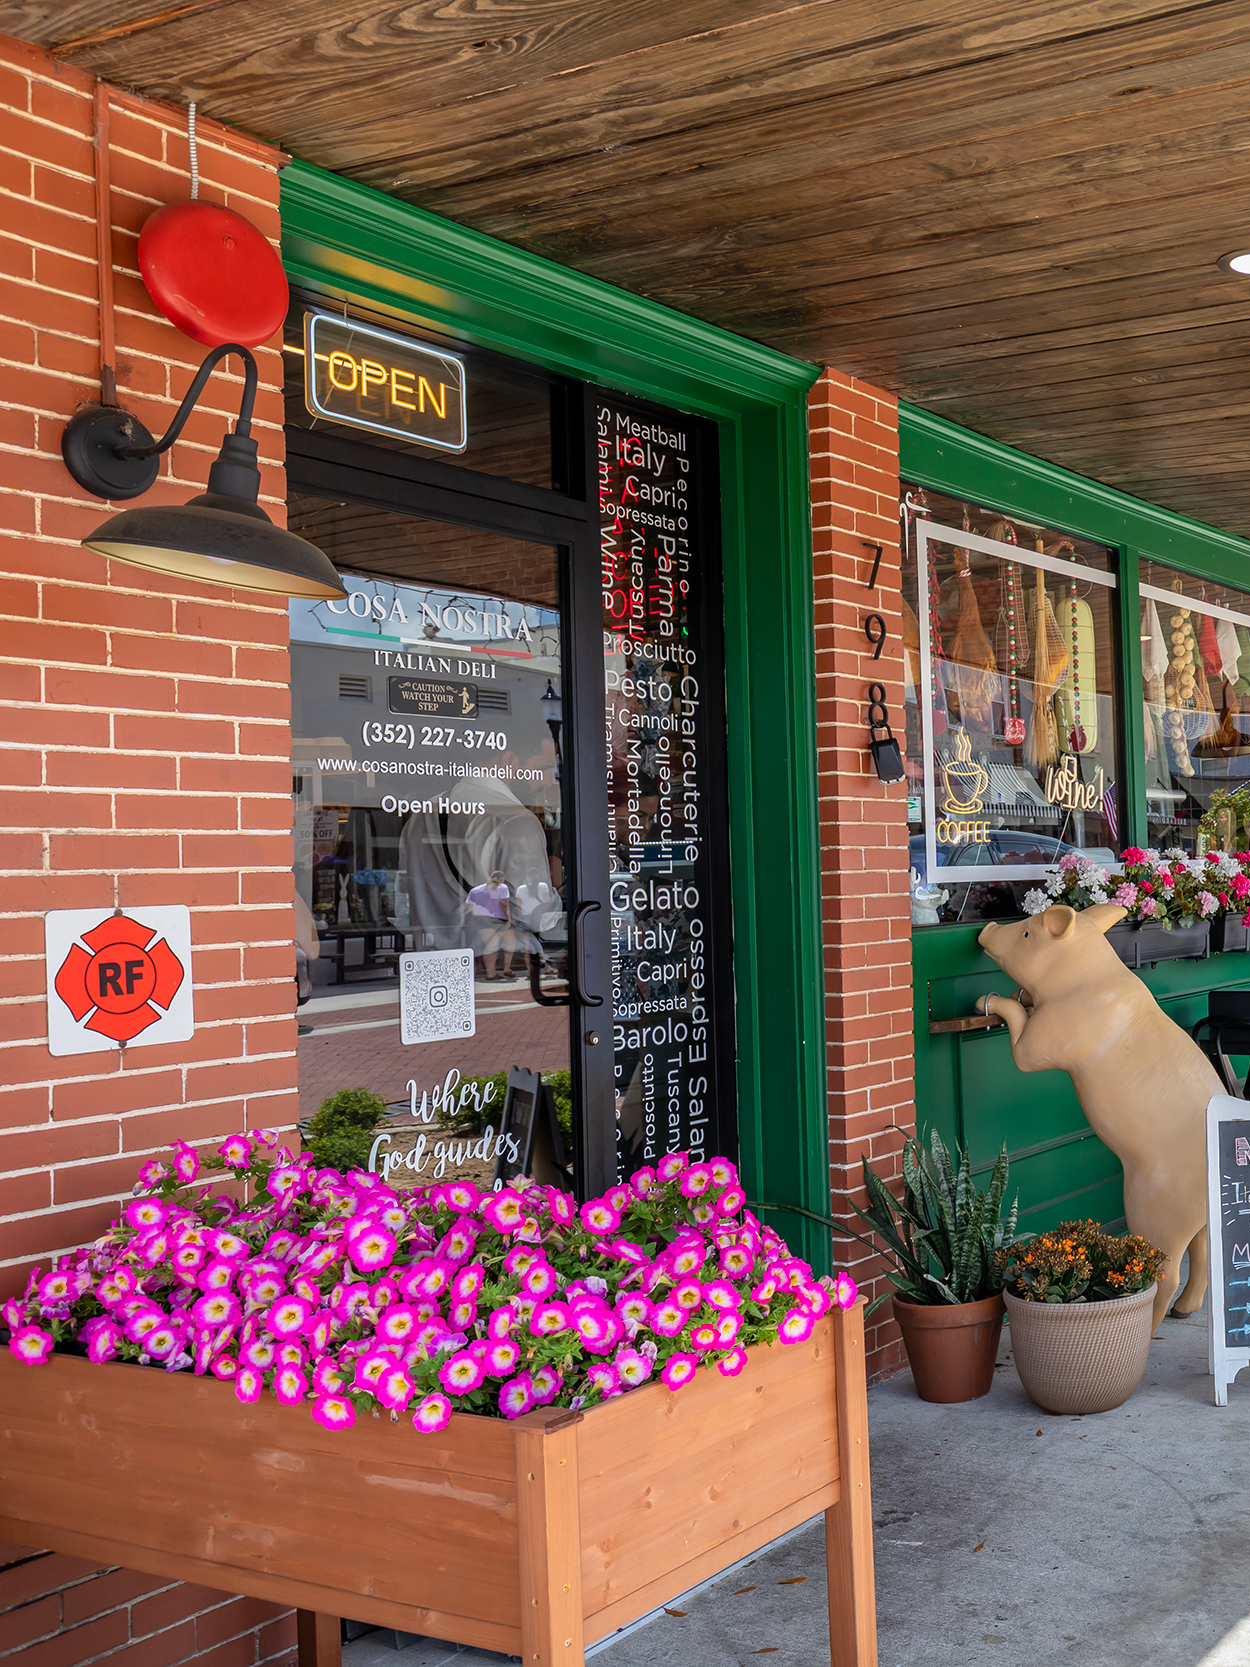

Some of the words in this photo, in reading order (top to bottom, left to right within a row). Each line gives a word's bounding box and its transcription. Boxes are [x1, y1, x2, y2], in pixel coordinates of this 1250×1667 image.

[328, 350, 446, 419] OPEN
[615, 412, 686, 452] Meatball
[597, 407, 613, 493] Salami
[615, 434, 666, 477] Italy
[625, 475, 676, 508] Capri
[600, 497, 676, 532] Sopressata
[676, 457, 692, 594] Pecorino
[600, 525, 619, 610] Wine
[629, 528, 646, 634] Tuscany
[657, 534, 676, 637] Parma
[326, 591, 409, 625] COSA
[418, 601, 534, 643] NOSTRA
[374, 649, 451, 674] ITALIAN
[458, 659, 497, 679] DELI
[603, 631, 697, 665] Prosciutto
[402, 691, 431, 702] WATCH
[431, 693, 454, 704] YOUR
[412, 682, 446, 693] CAUTION
[605, 669, 672, 702] Pesto
[418, 701, 439, 712] STEP
[618, 708, 679, 732] Cannoli
[362, 720, 415, 749] (352)
[420, 726, 507, 751] 227-3740
[317, 757, 544, 781] www.cosanostra-italiandeli.com
[680, 675, 703, 862] Charcuterie
[381, 794, 433, 817] Open
[438, 797, 486, 816] Hours
[626, 739, 645, 874] Mortadella
[655, 736, 673, 874] Limoncello
[318, 829, 333, 838] OFF
[937, 821, 992, 843] COFFEE
[609, 880, 700, 912] Gelato
[627, 922, 677, 955] Italy
[98, 959, 144, 998] RF
[636, 957, 688, 985] Capri
[612, 995, 687, 1018] Sopressata
[688, 918, 710, 1063] Espresso
[613, 1017, 688, 1052] Barolo
[406, 1068, 498, 1124] Where
[642, 1053, 656, 1159] Prosciutto
[666, 1051, 682, 1156] Tuscany
[368, 1133, 431, 1182] God
[433, 1124, 521, 1179] guides
